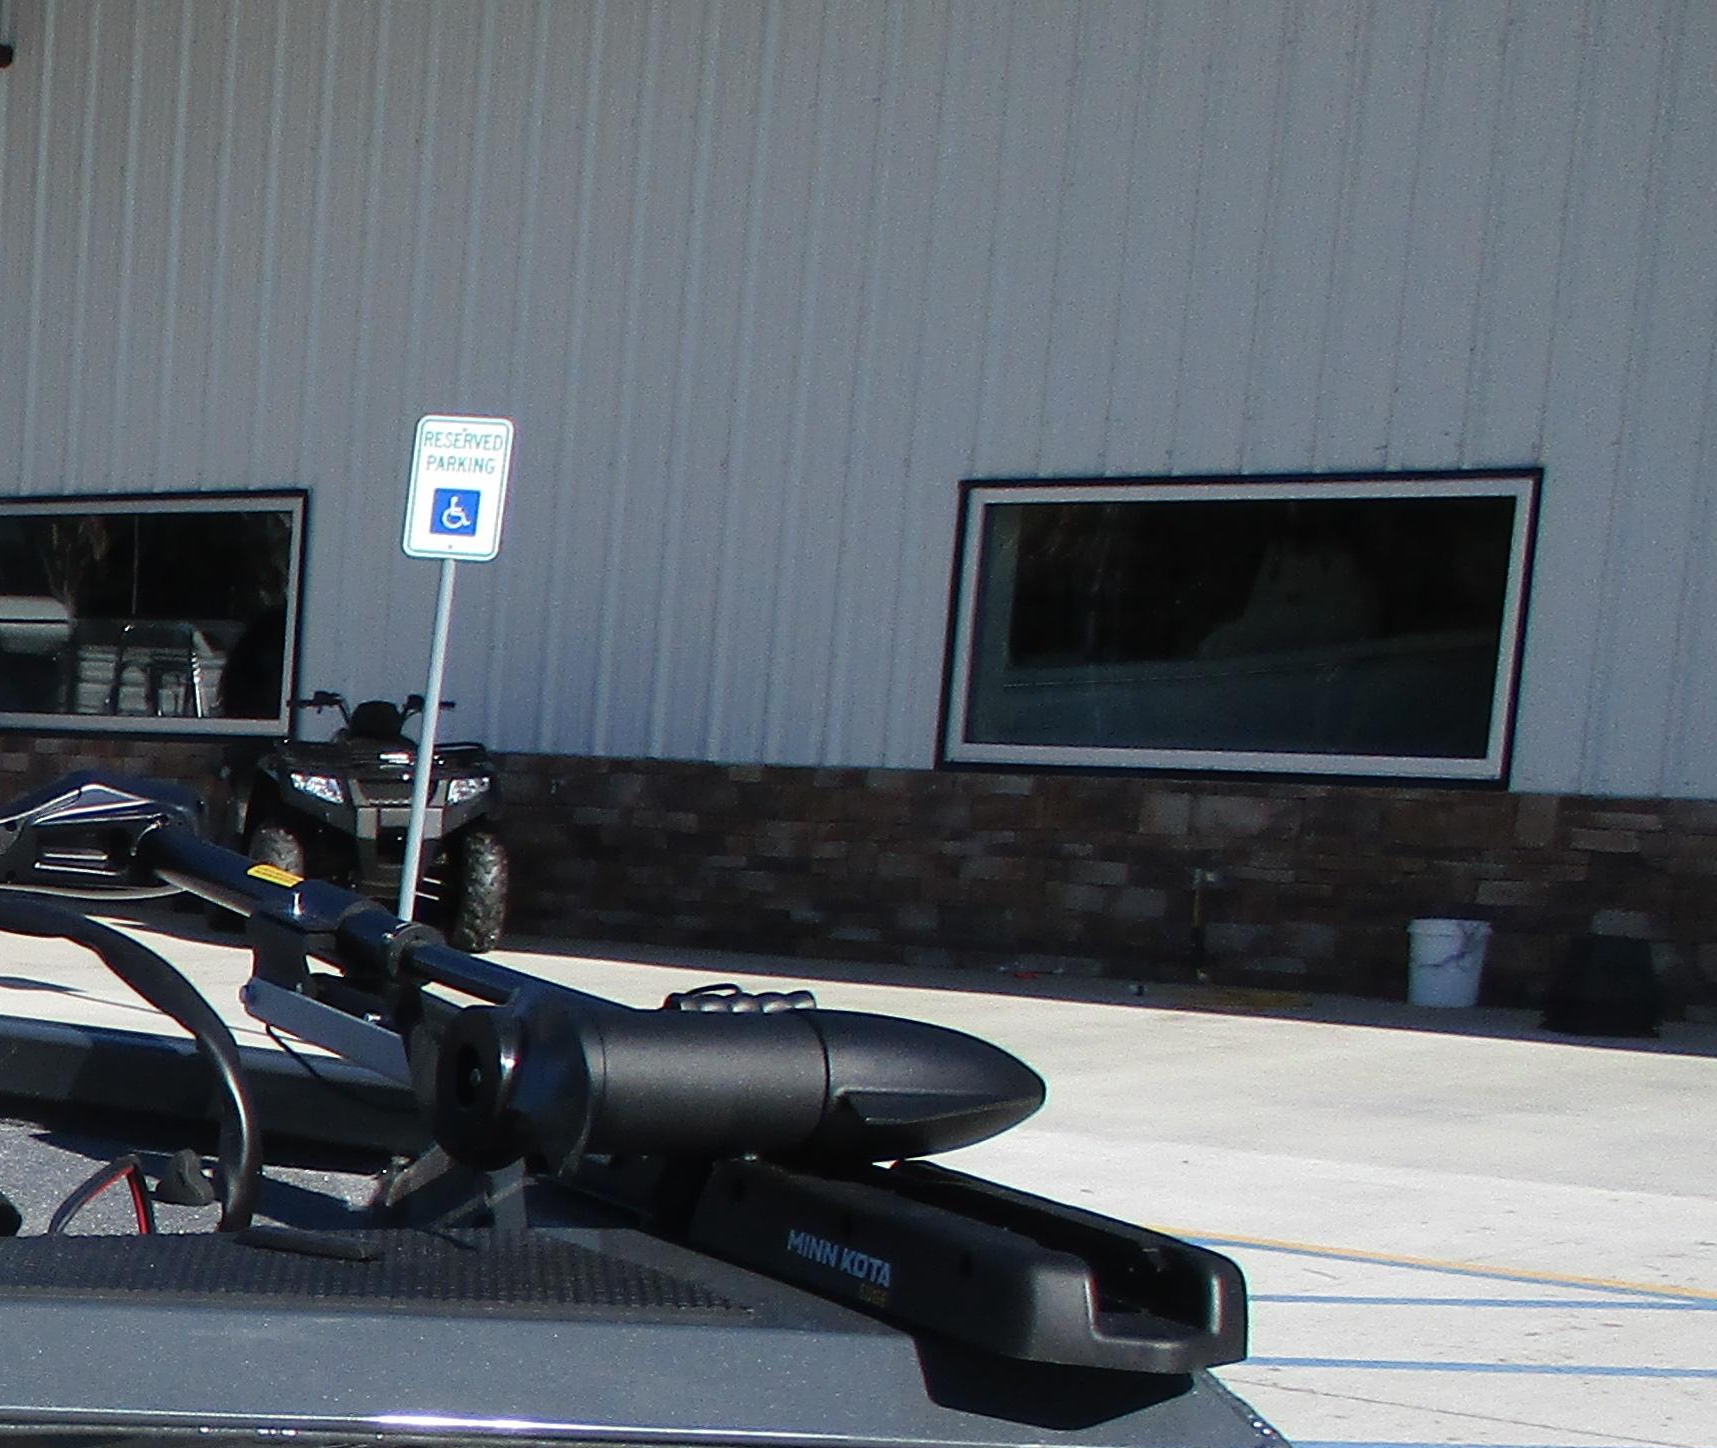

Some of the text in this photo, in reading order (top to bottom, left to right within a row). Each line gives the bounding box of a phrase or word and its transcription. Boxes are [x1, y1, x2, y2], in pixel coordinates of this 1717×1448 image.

[423, 431, 504, 452] RESERVED
[426, 455, 496, 475] PARKING
[786, 1228, 892, 1288] MINN KOTA
